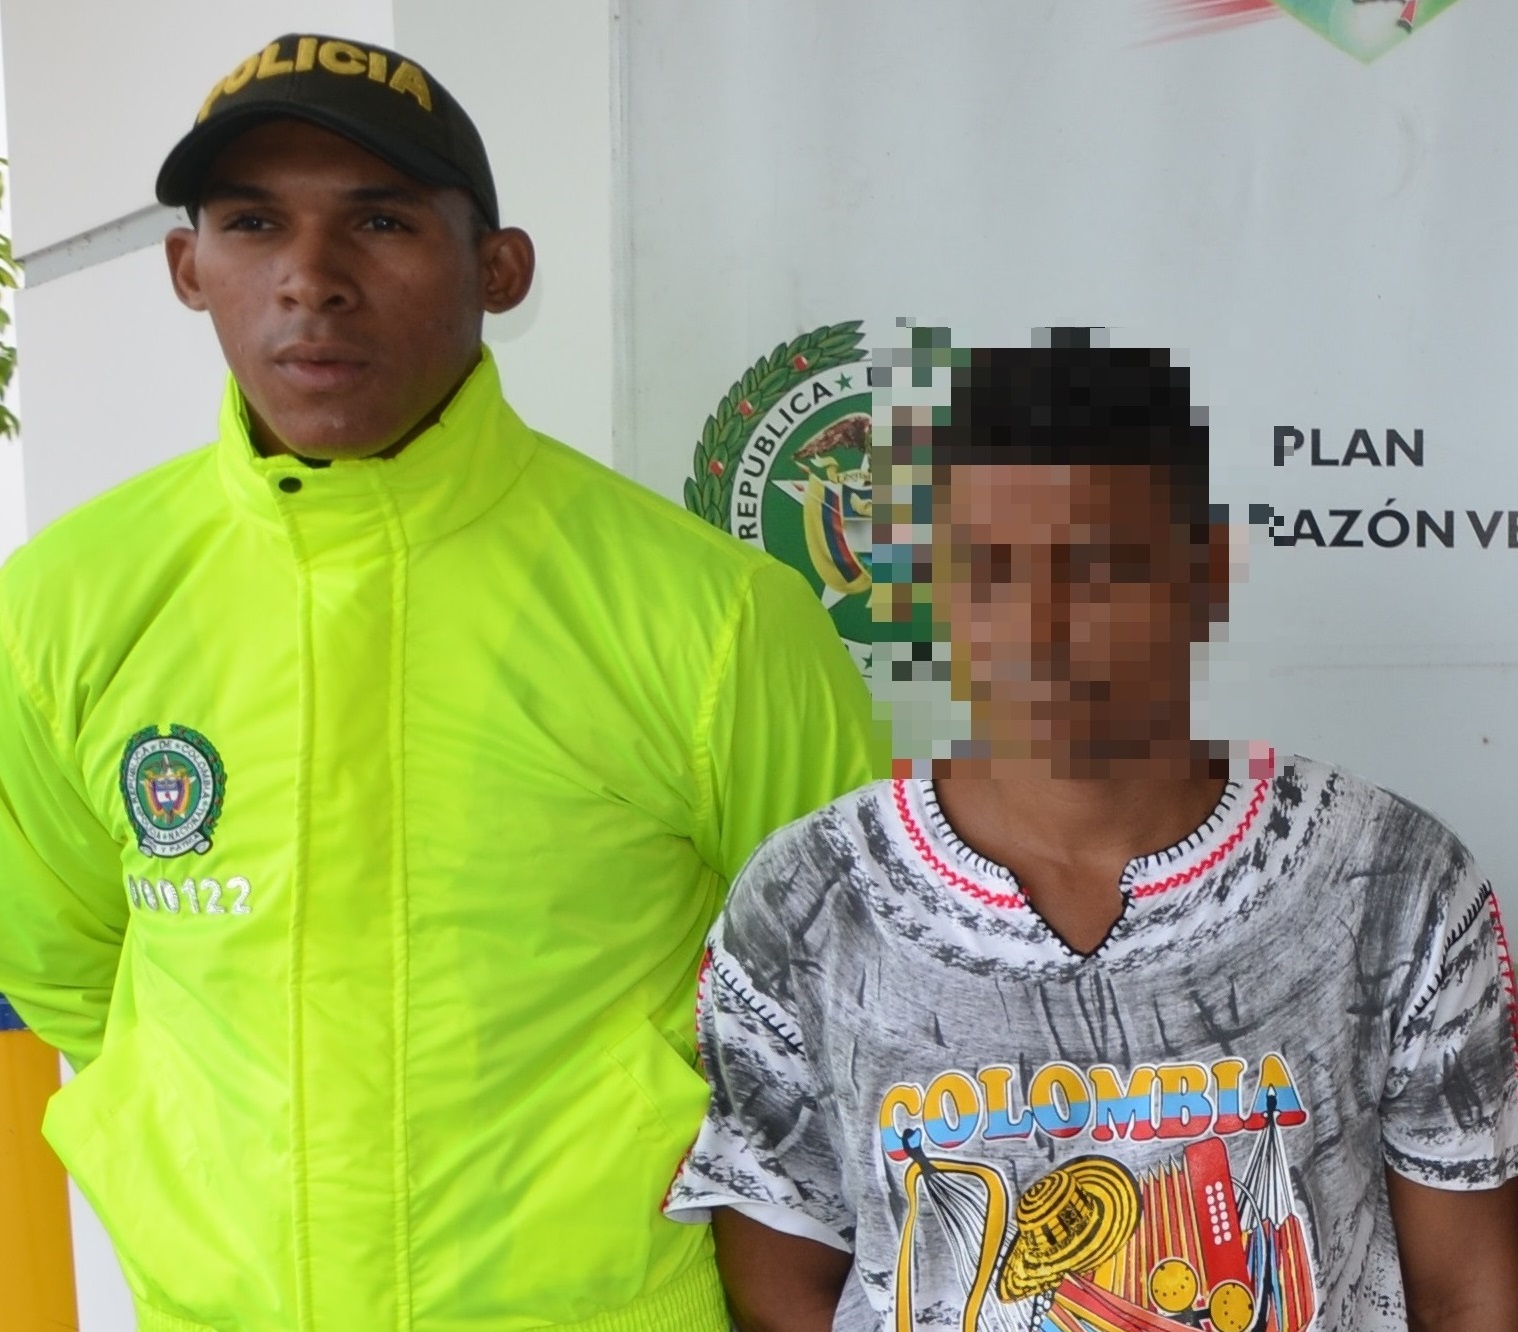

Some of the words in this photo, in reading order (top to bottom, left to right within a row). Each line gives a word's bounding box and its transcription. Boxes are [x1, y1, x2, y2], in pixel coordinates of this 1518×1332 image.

[1274, 426, 1424, 467] PLAN
[1274, 498, 1455, 548] AZÓN
[879, 1053, 1309, 1161] COLOMBIA
